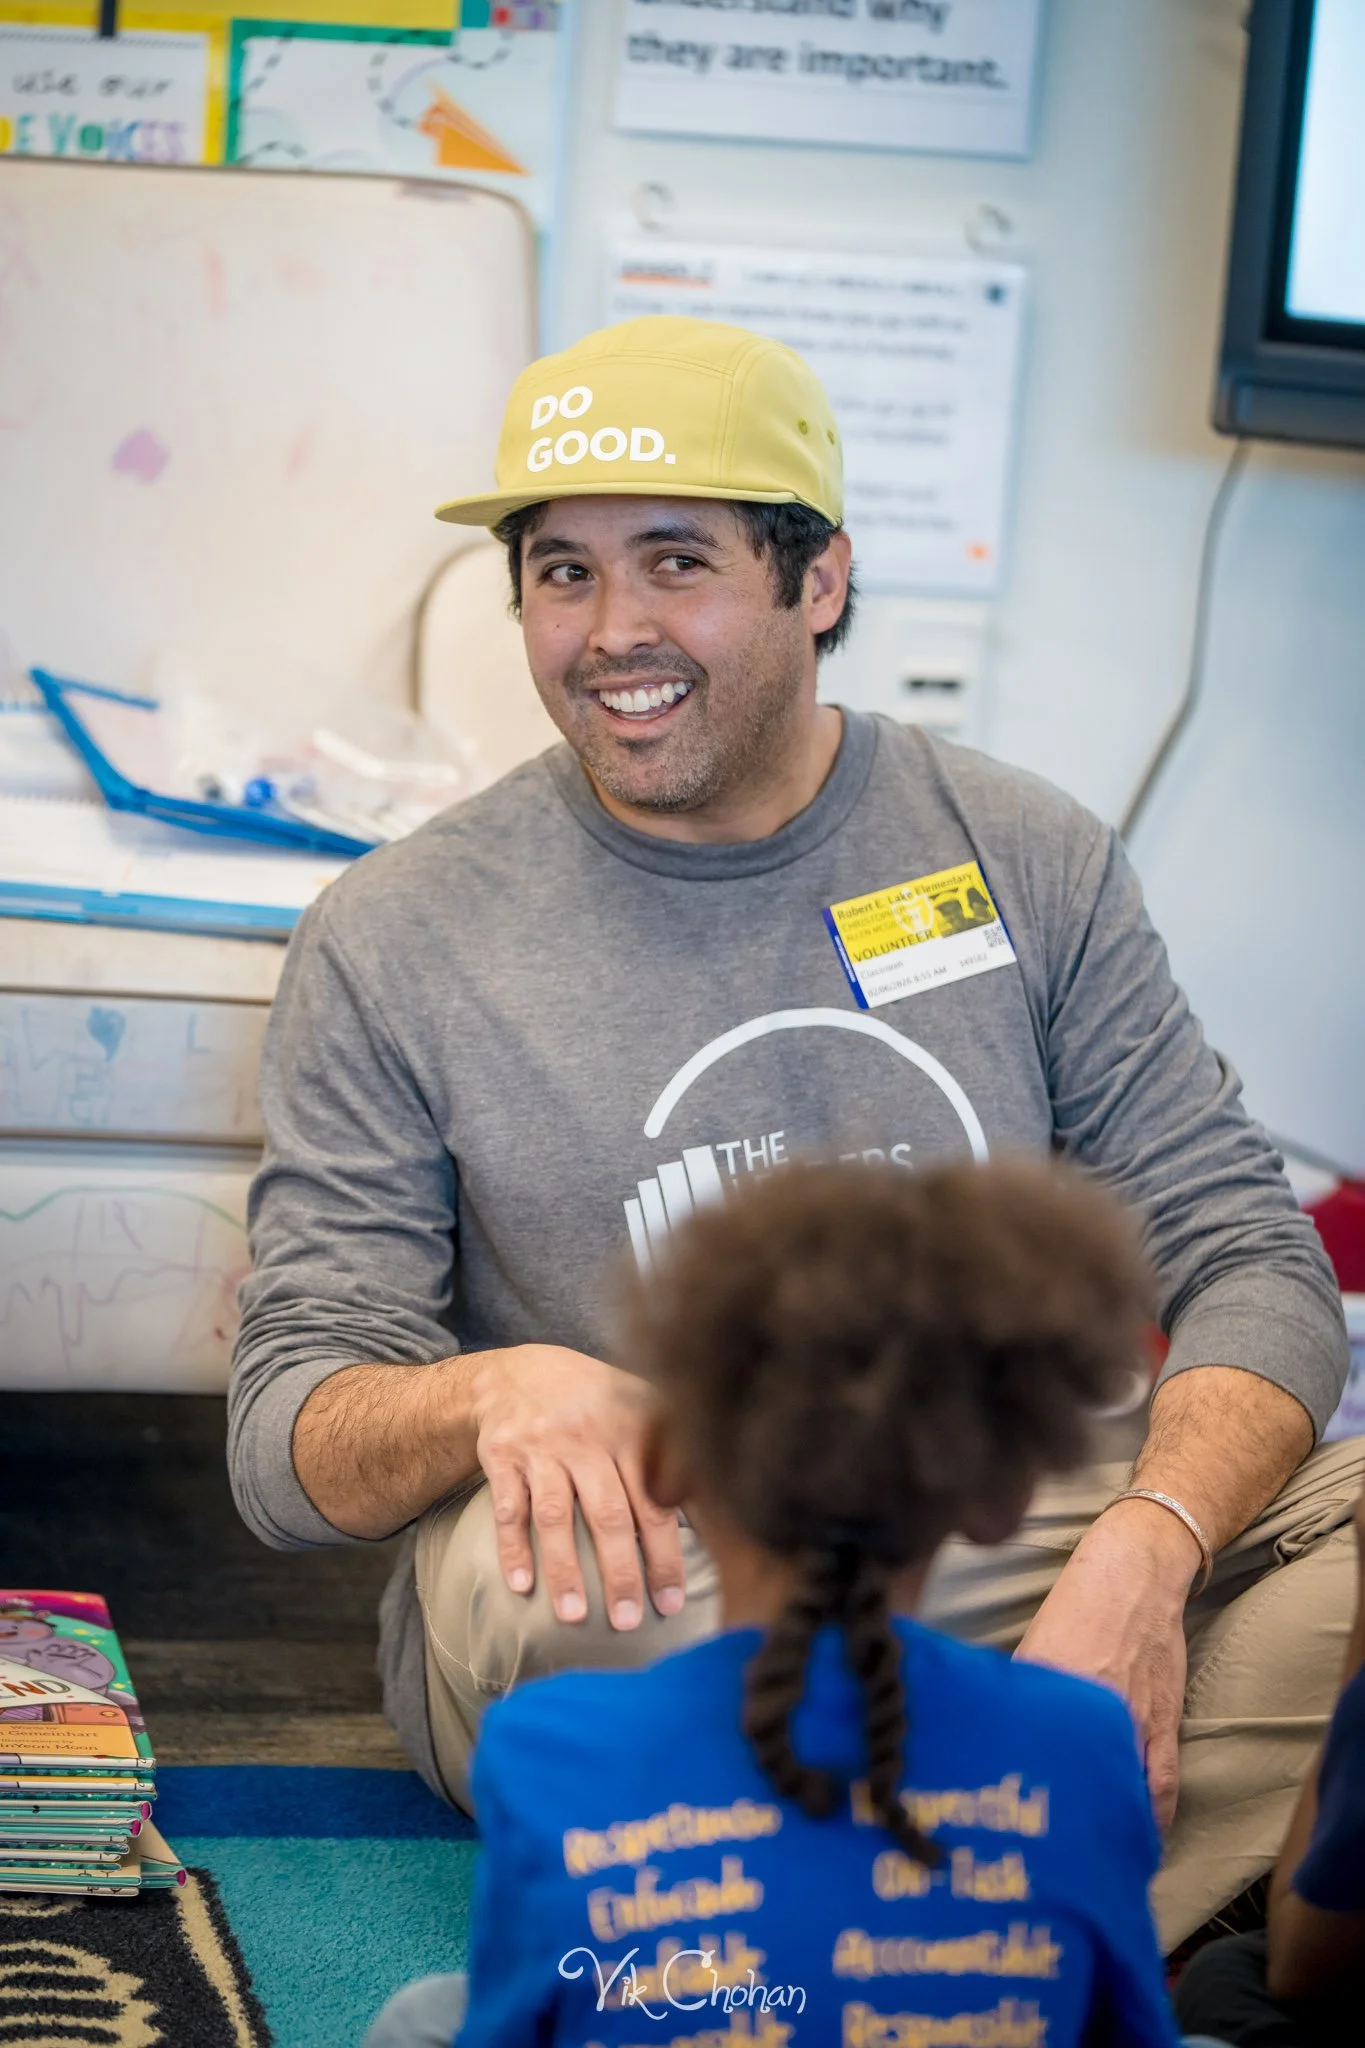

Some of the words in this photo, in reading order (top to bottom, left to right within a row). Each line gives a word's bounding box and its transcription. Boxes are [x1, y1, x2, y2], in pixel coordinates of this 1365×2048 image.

[627, 31, 712, 74] they
[724, 43, 790, 74] are
[800, 40, 1009, 89] important.
[12, 69, 79, 96] use
[531, 386, 593, 430] DO
[527, 427, 677, 473] GOOD.
[837, 903, 873, 920] Robert
[887, 889, 912, 905] Lake
[915, 872, 973, 896] Elementary
[853, 929, 935, 962] VOLUNTEER
[933, 965, 948, 977] AM
[716, 1130, 789, 1175] THE
